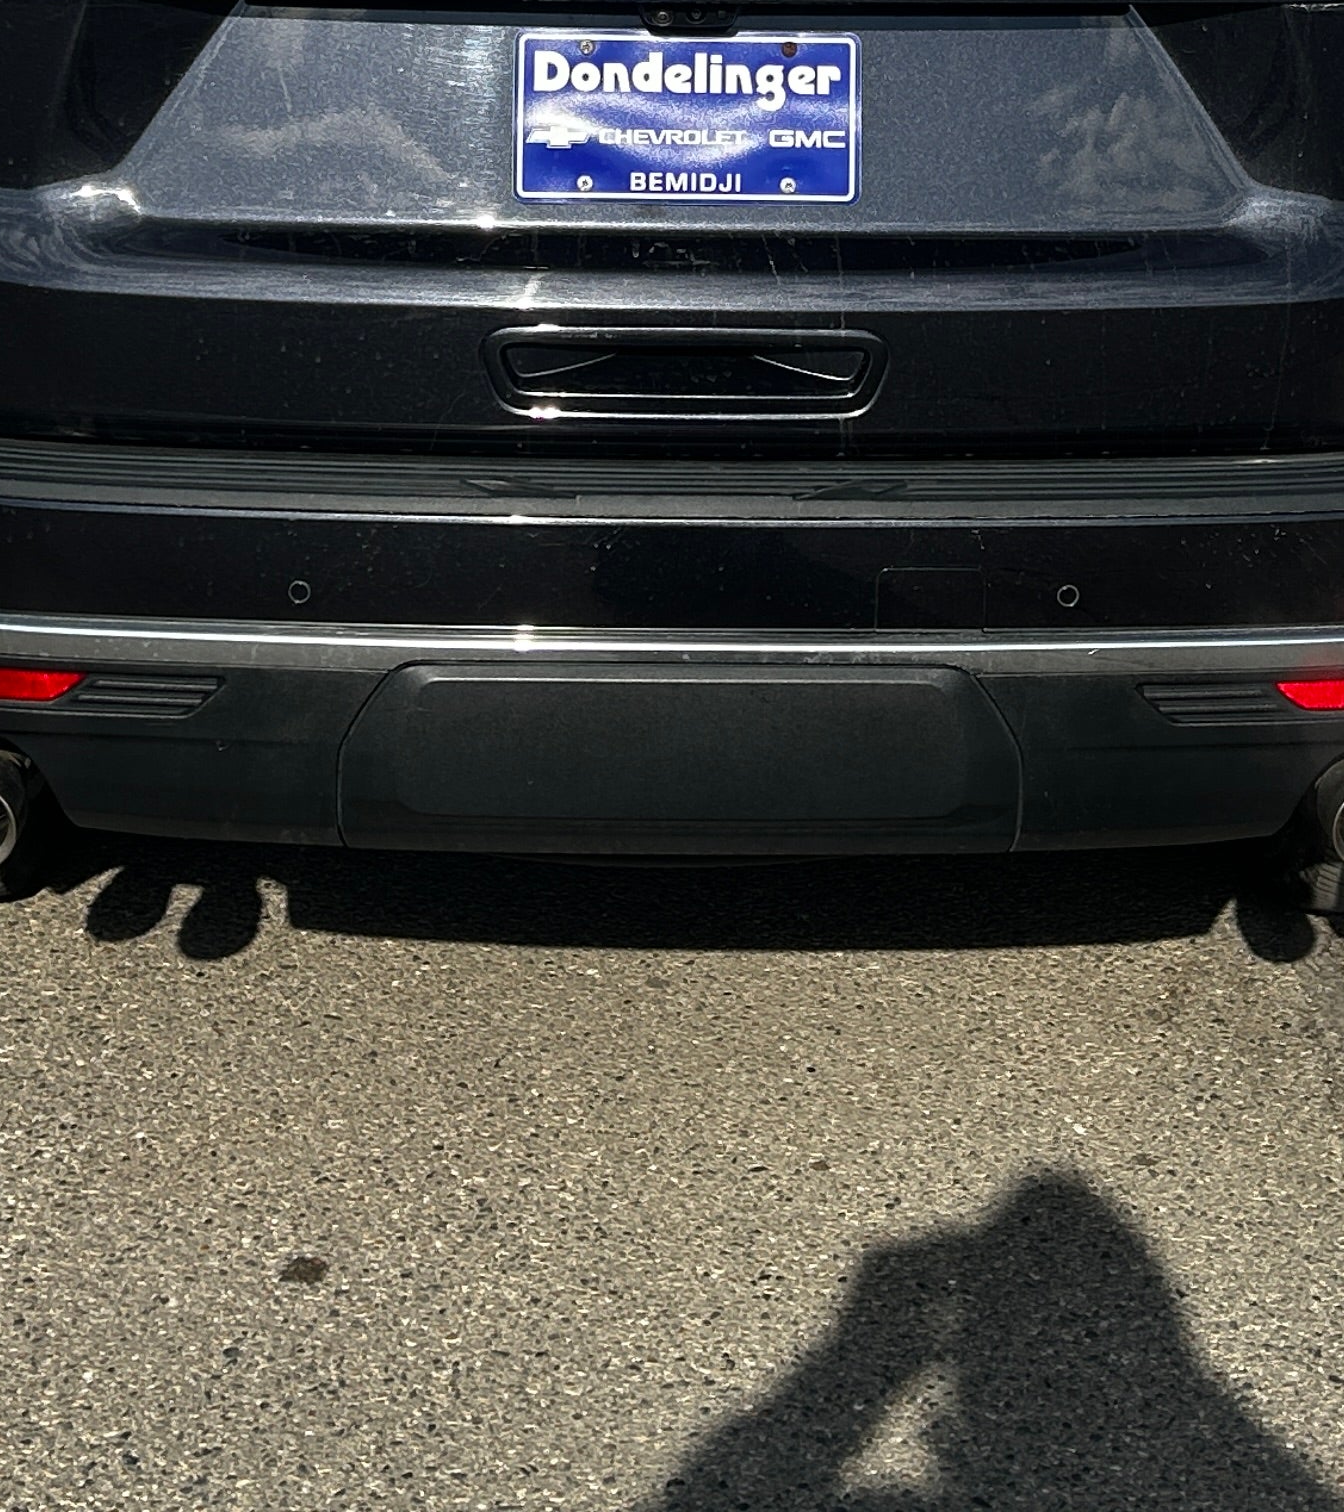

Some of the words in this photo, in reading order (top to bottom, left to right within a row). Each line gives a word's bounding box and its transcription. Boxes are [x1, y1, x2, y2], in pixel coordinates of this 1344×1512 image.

[533, 50, 842, 112] Dondelinger
[598, 129, 746, 146] CHEVROLET
[769, 130, 846, 148] GMC
[629, 172, 742, 192] BEMIDJI
